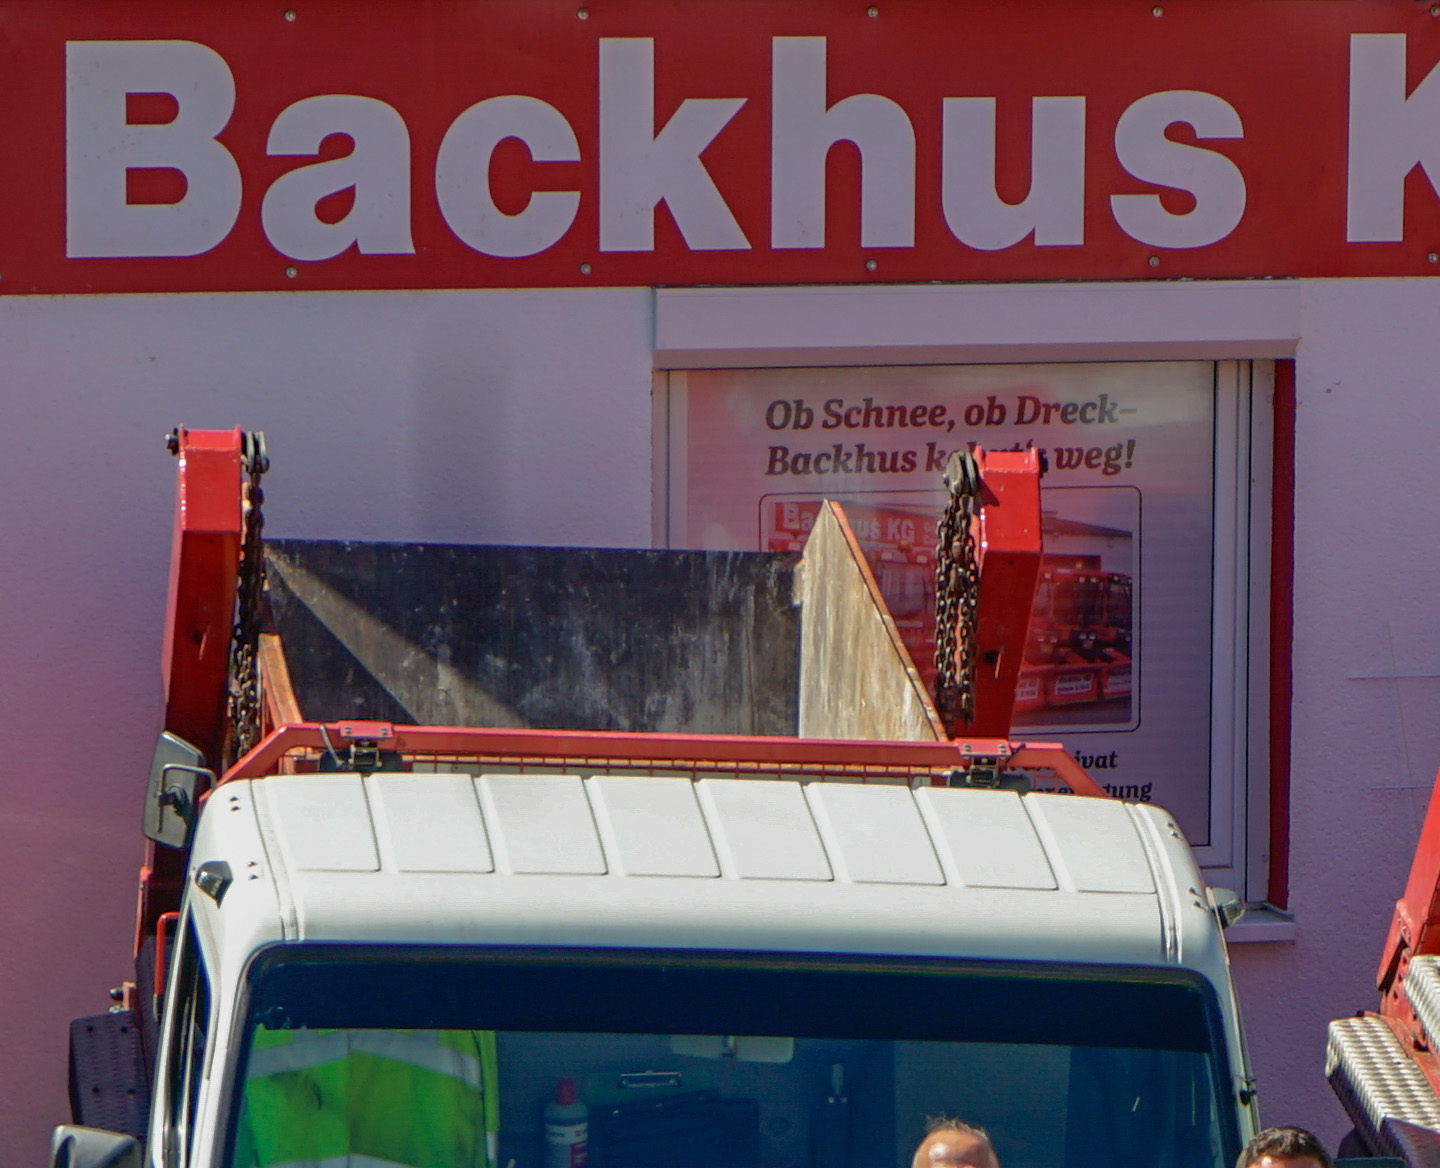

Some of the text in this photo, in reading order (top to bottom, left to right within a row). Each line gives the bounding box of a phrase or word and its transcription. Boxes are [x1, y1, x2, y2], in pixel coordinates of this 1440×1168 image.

[66, 36, 1246, 261] Backhus
[766, 399, 813, 430] Ob
[822, 397, 955, 432] Schnee,
[965, 395, 1006, 426] ob
[765, 442, 917, 476] Backhus
[1054, 439, 1135, 476] weg!
